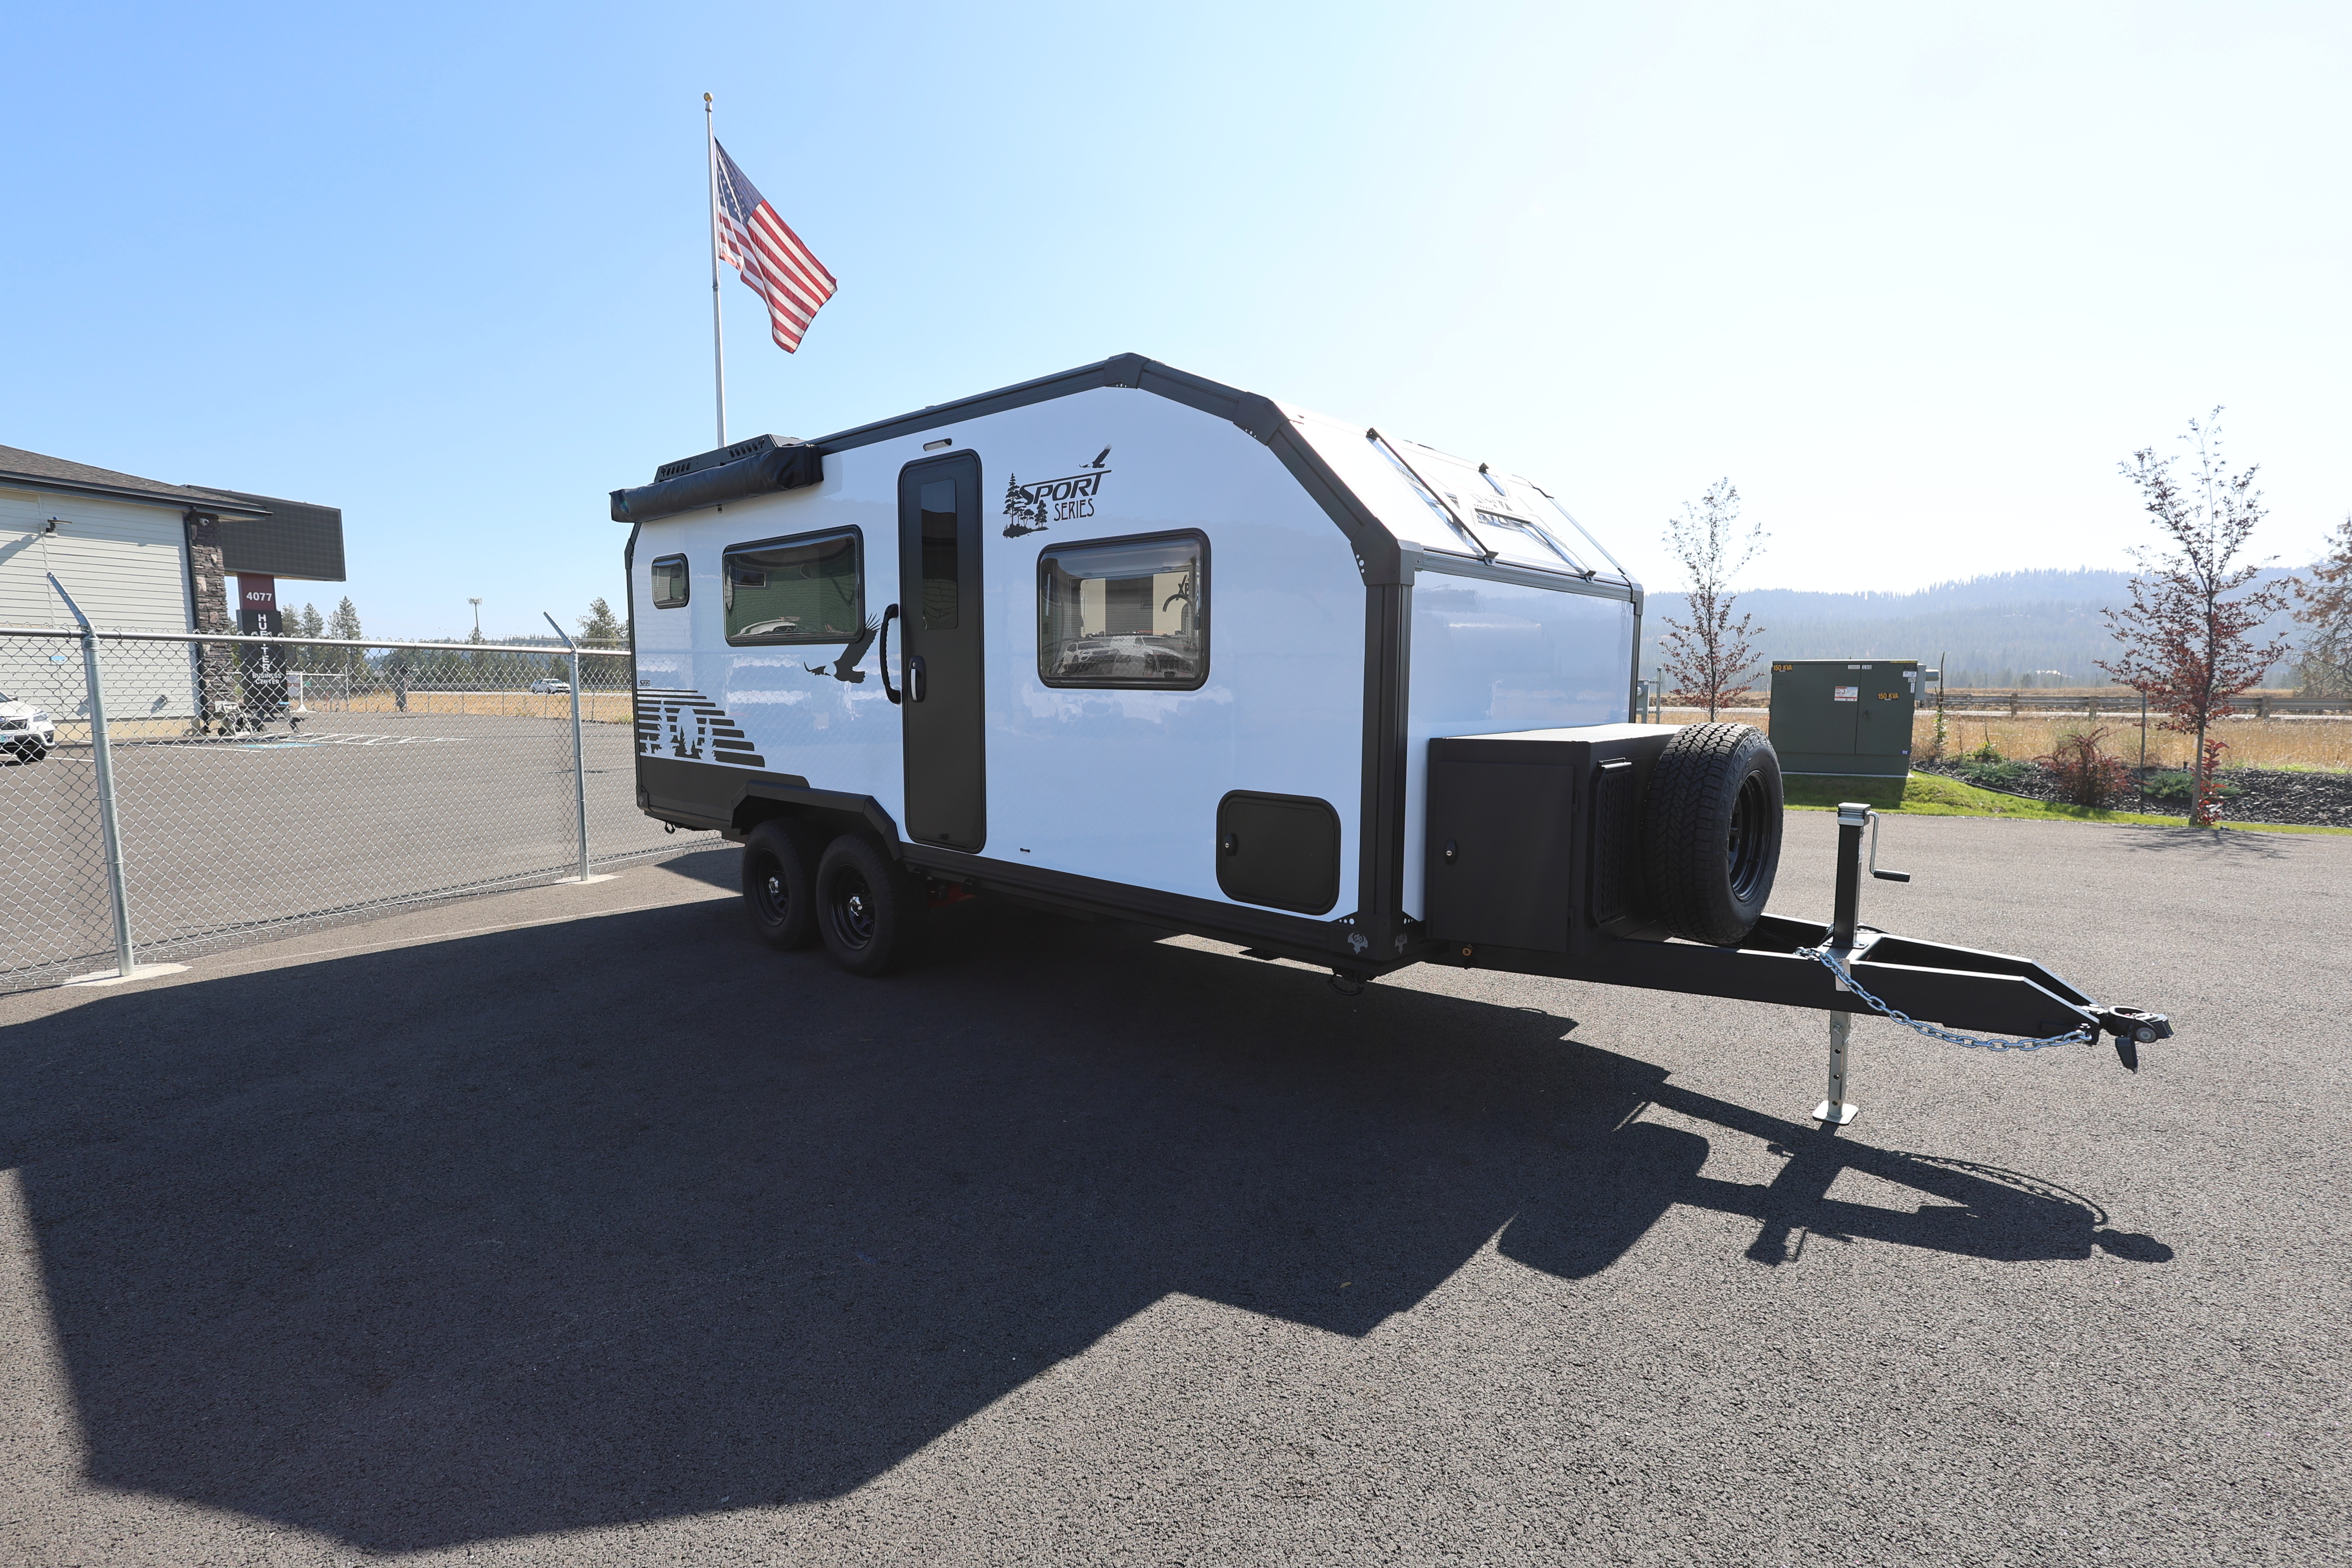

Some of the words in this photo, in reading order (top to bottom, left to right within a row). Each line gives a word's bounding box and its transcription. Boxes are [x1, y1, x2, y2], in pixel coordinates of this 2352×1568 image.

[1014, 470, 1112, 506] SPORT
[1054, 498, 1094, 521] SERIES
[246, 592, 272, 601] 4077
[258, 613, 271, 671] HUETER
